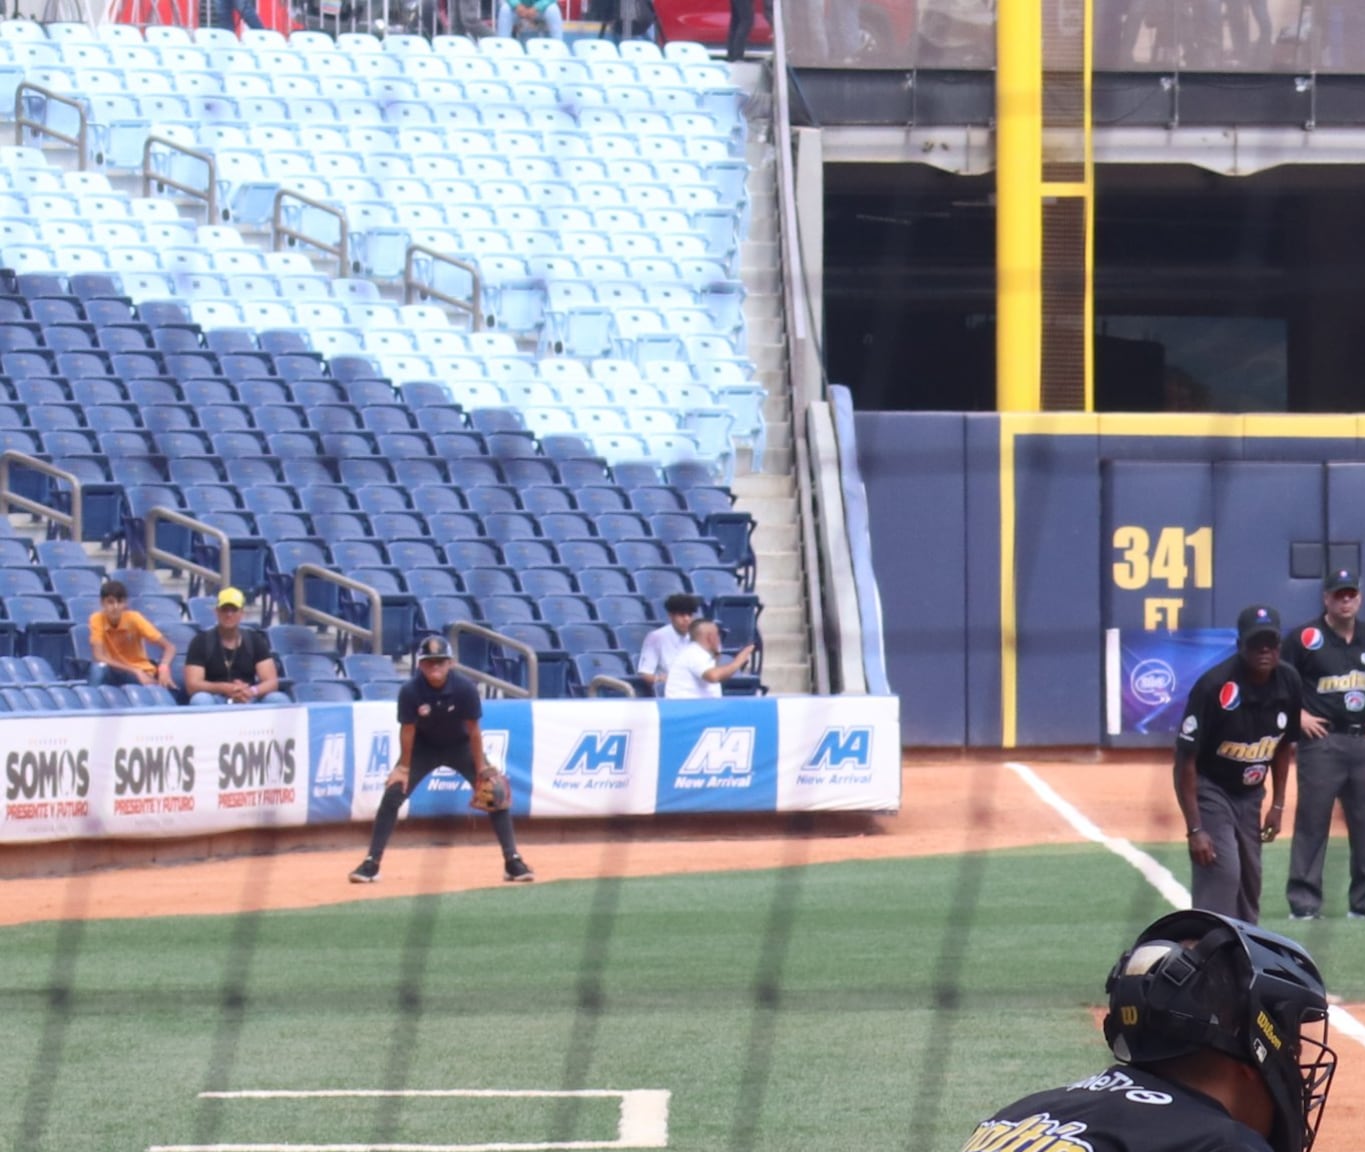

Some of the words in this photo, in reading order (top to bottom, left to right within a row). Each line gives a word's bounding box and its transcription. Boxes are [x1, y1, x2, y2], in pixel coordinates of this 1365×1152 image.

[1113, 525, 1212, 590] 341
[1144, 598, 1183, 632] FT
[114, 745, 196, 795] SOMOS
[218, 738, 296, 789] SOMOS
[6, 749, 90, 800] SOMOS
[427, 779, 456, 791] New
[552, 778, 579, 789] New
[584, 779, 628, 789] Arrival
[674, 776, 704, 789] New
[708, 776, 752, 788] Arrival
[796, 775, 823, 785] New
[828, 774, 872, 785] Arrival
[114, 799, 154, 816] PRESENTE
[163, 797, 195, 813] FUTURO
[218, 792, 257, 809] PRESENTE
[264, 788, 295, 805] FUTURO
[6, 803, 48, 820] PRESENTE
[58, 801, 88, 817] FUTURO
[1256, 1010, 1282, 1050] Wilson
